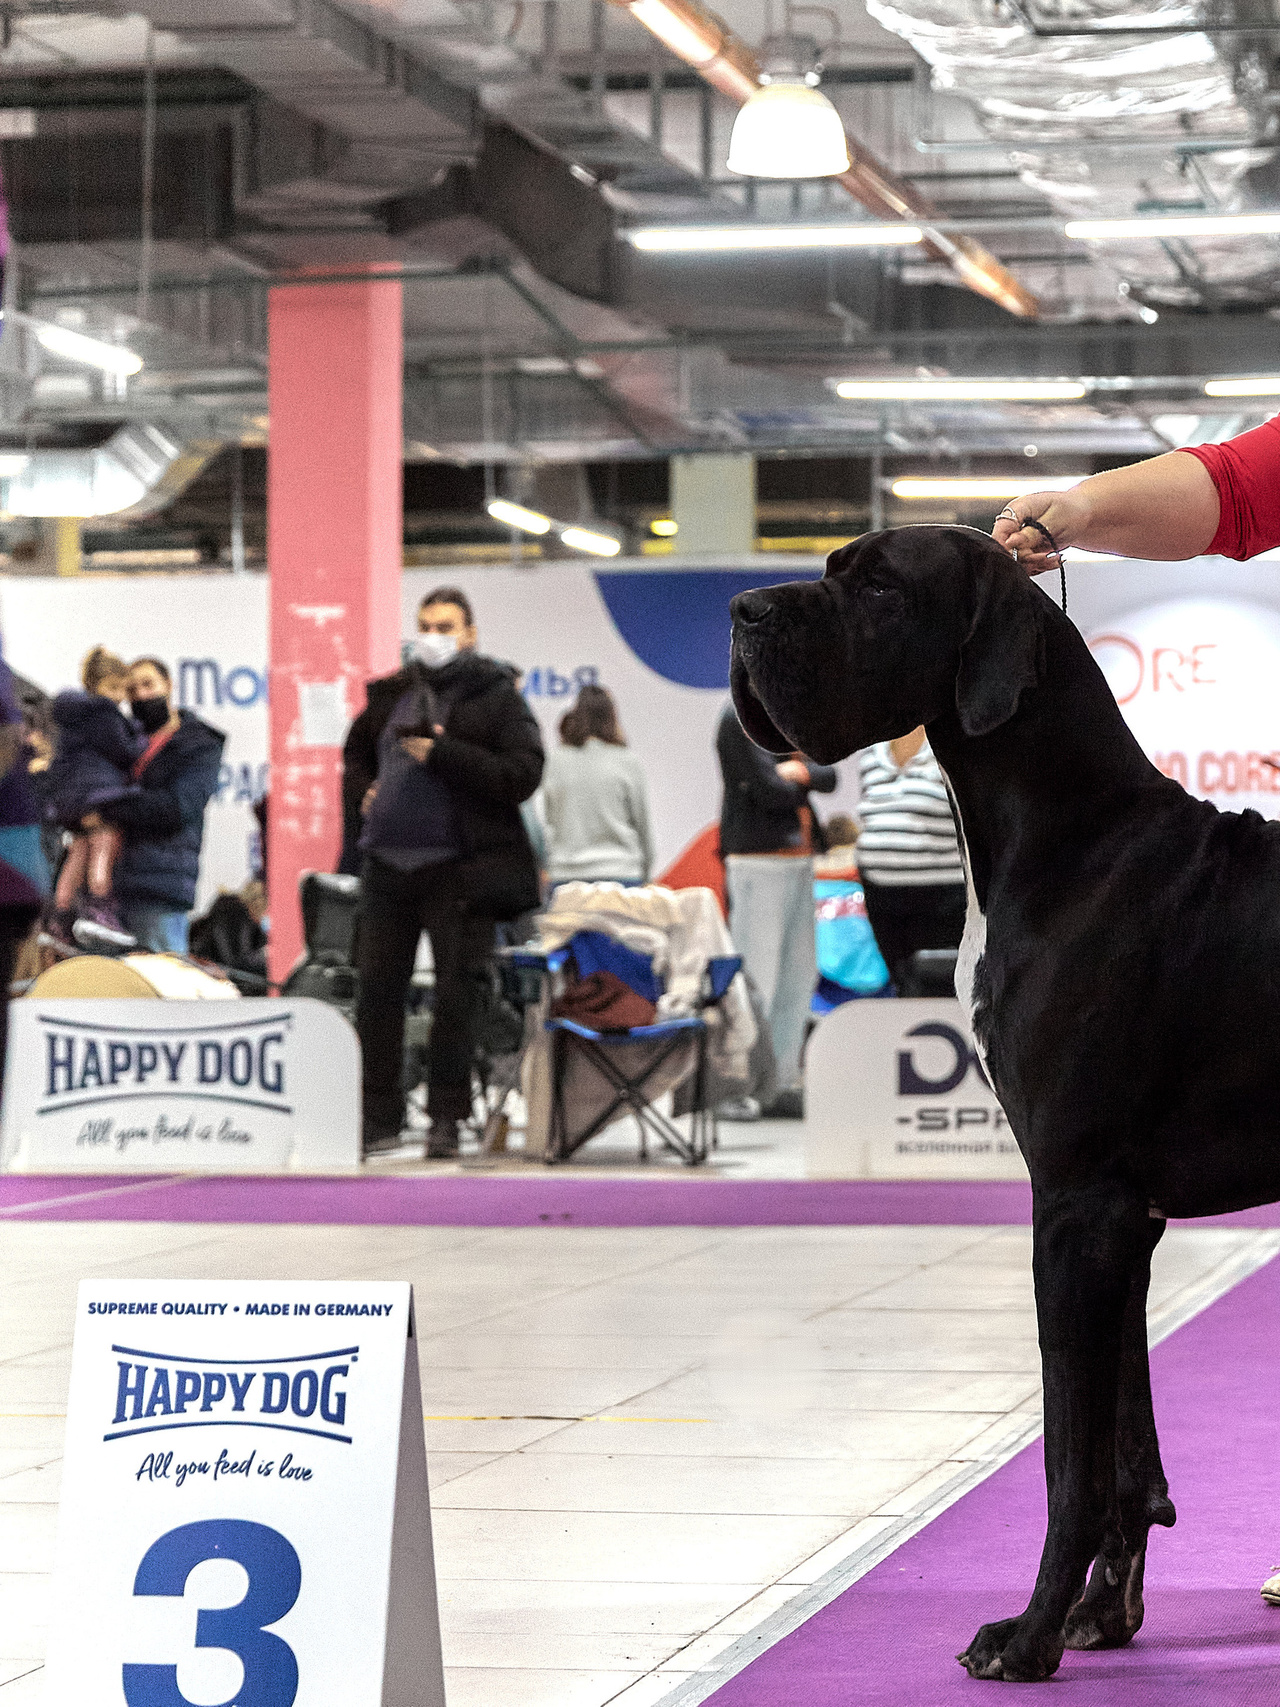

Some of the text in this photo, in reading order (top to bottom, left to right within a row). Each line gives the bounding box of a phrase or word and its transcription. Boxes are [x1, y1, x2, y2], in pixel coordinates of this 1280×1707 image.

[46, 1032, 284, 1096] HAPPY DOG
[88, 1302, 393, 1317] SUPREME QUALITY MADE IN GERMANY
[112, 1361, 349, 1425] HAPPY DOG
[136, 1449, 313, 1487] All you feed is love
[122, 1518, 302, 1707] 3
